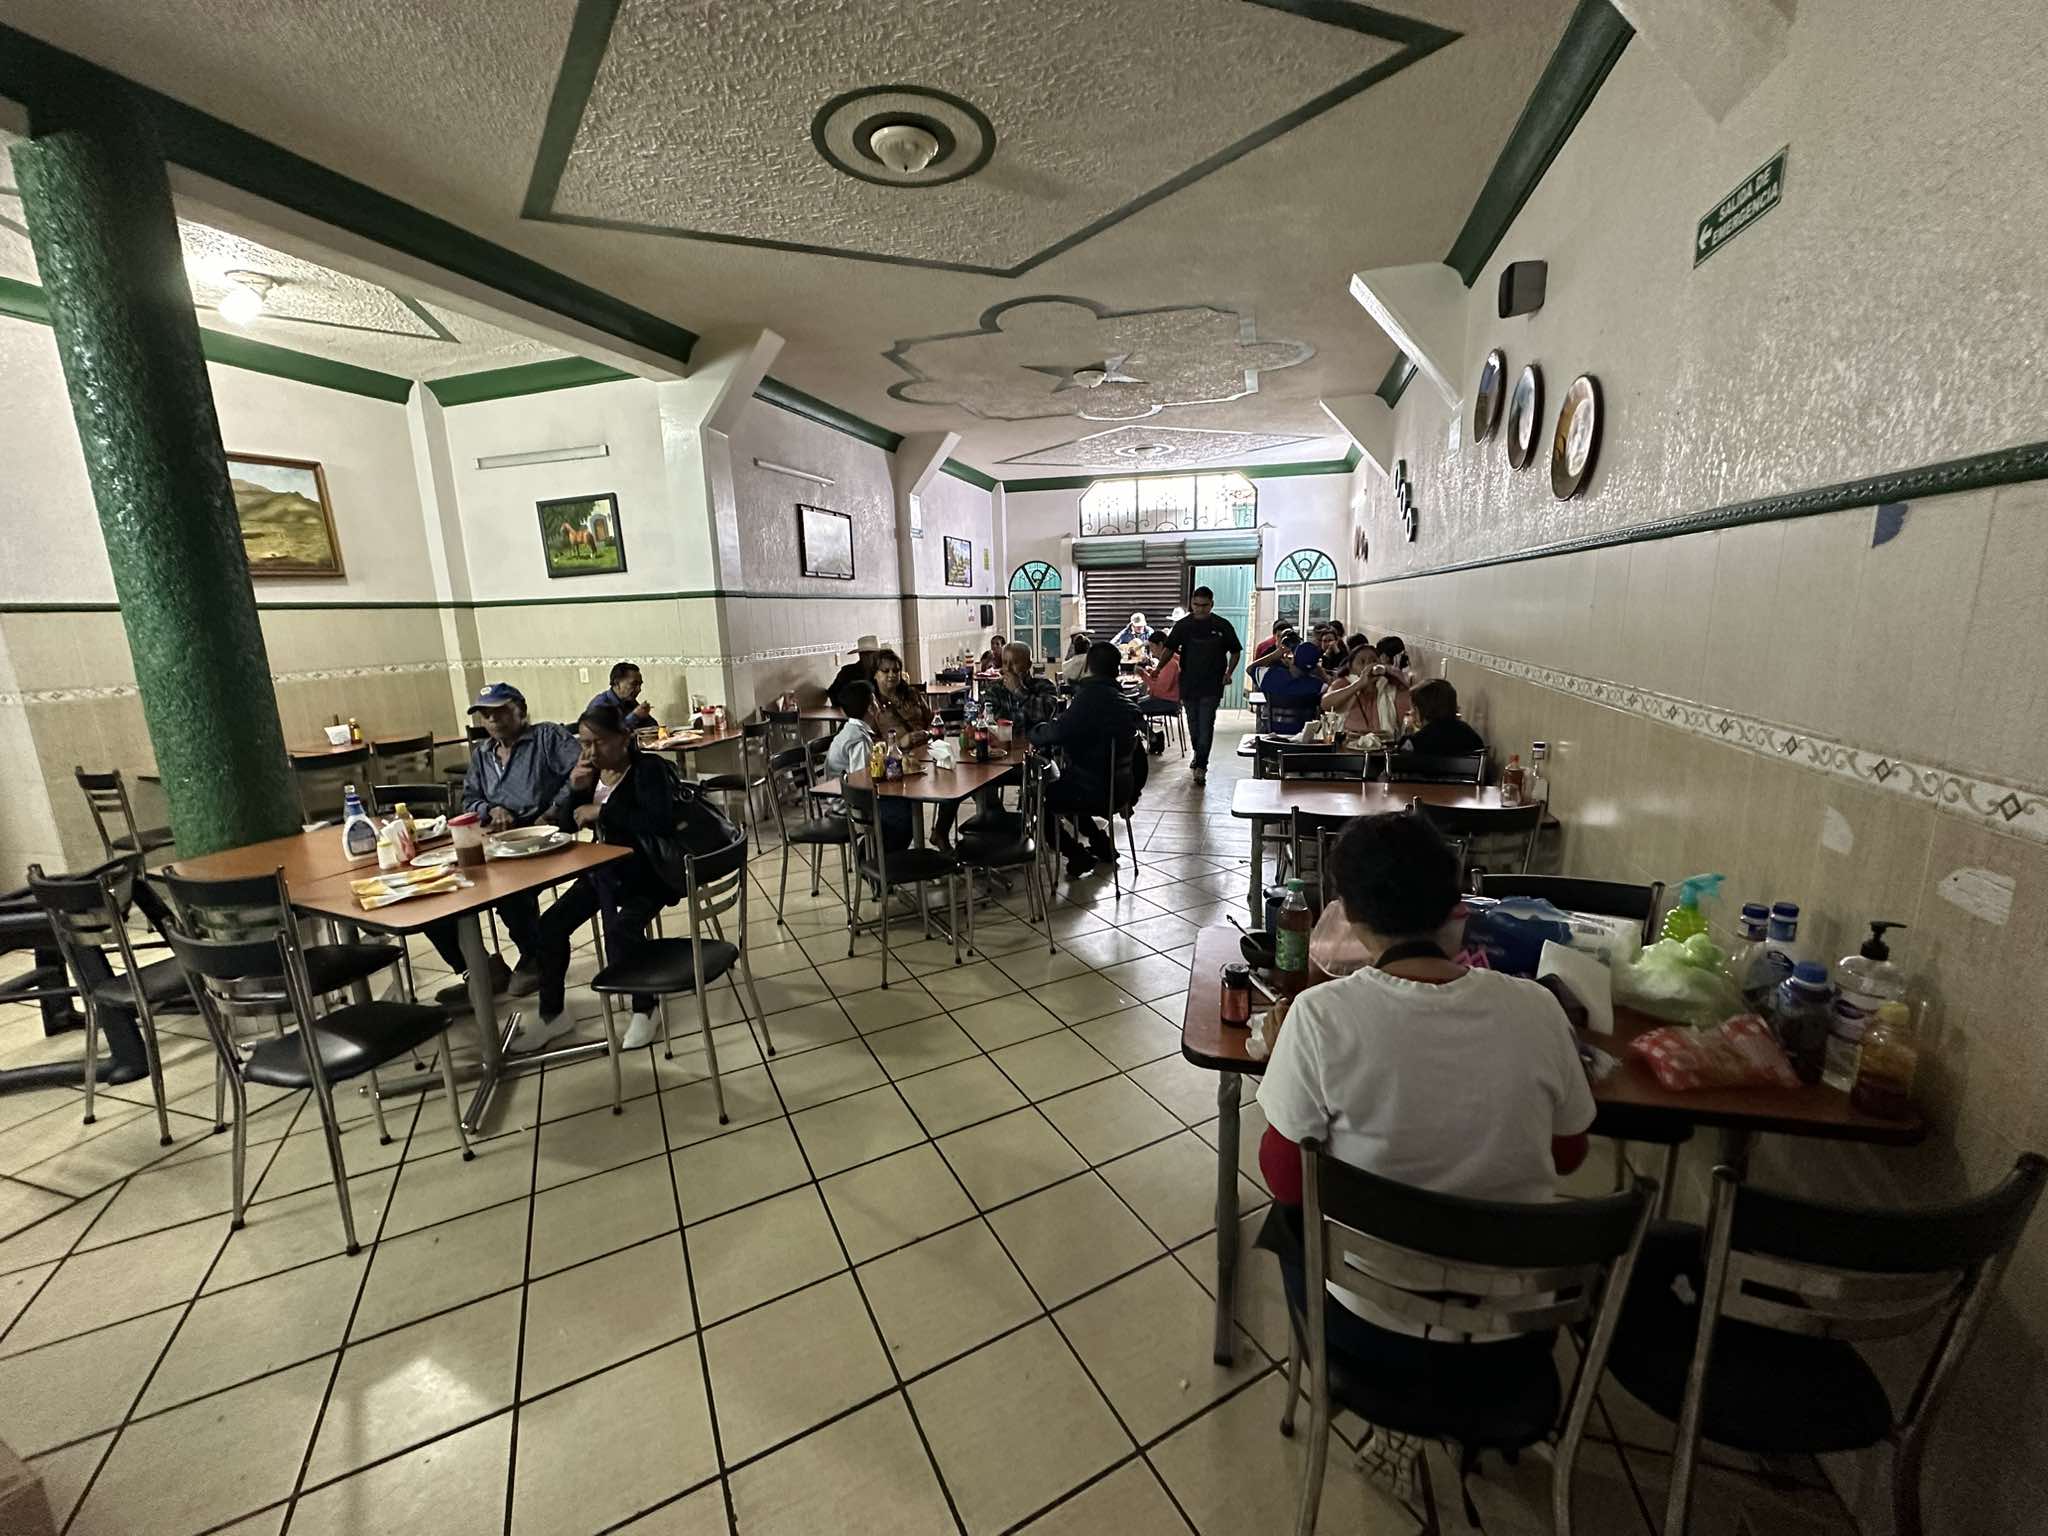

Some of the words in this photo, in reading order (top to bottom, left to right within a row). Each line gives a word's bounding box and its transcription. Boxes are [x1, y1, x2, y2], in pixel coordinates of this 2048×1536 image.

[1711, 181, 1778, 246] EMERGENCIA
[1718, 182, 1753, 222] SALIDA
[1755, 166, 1772, 192] DE
